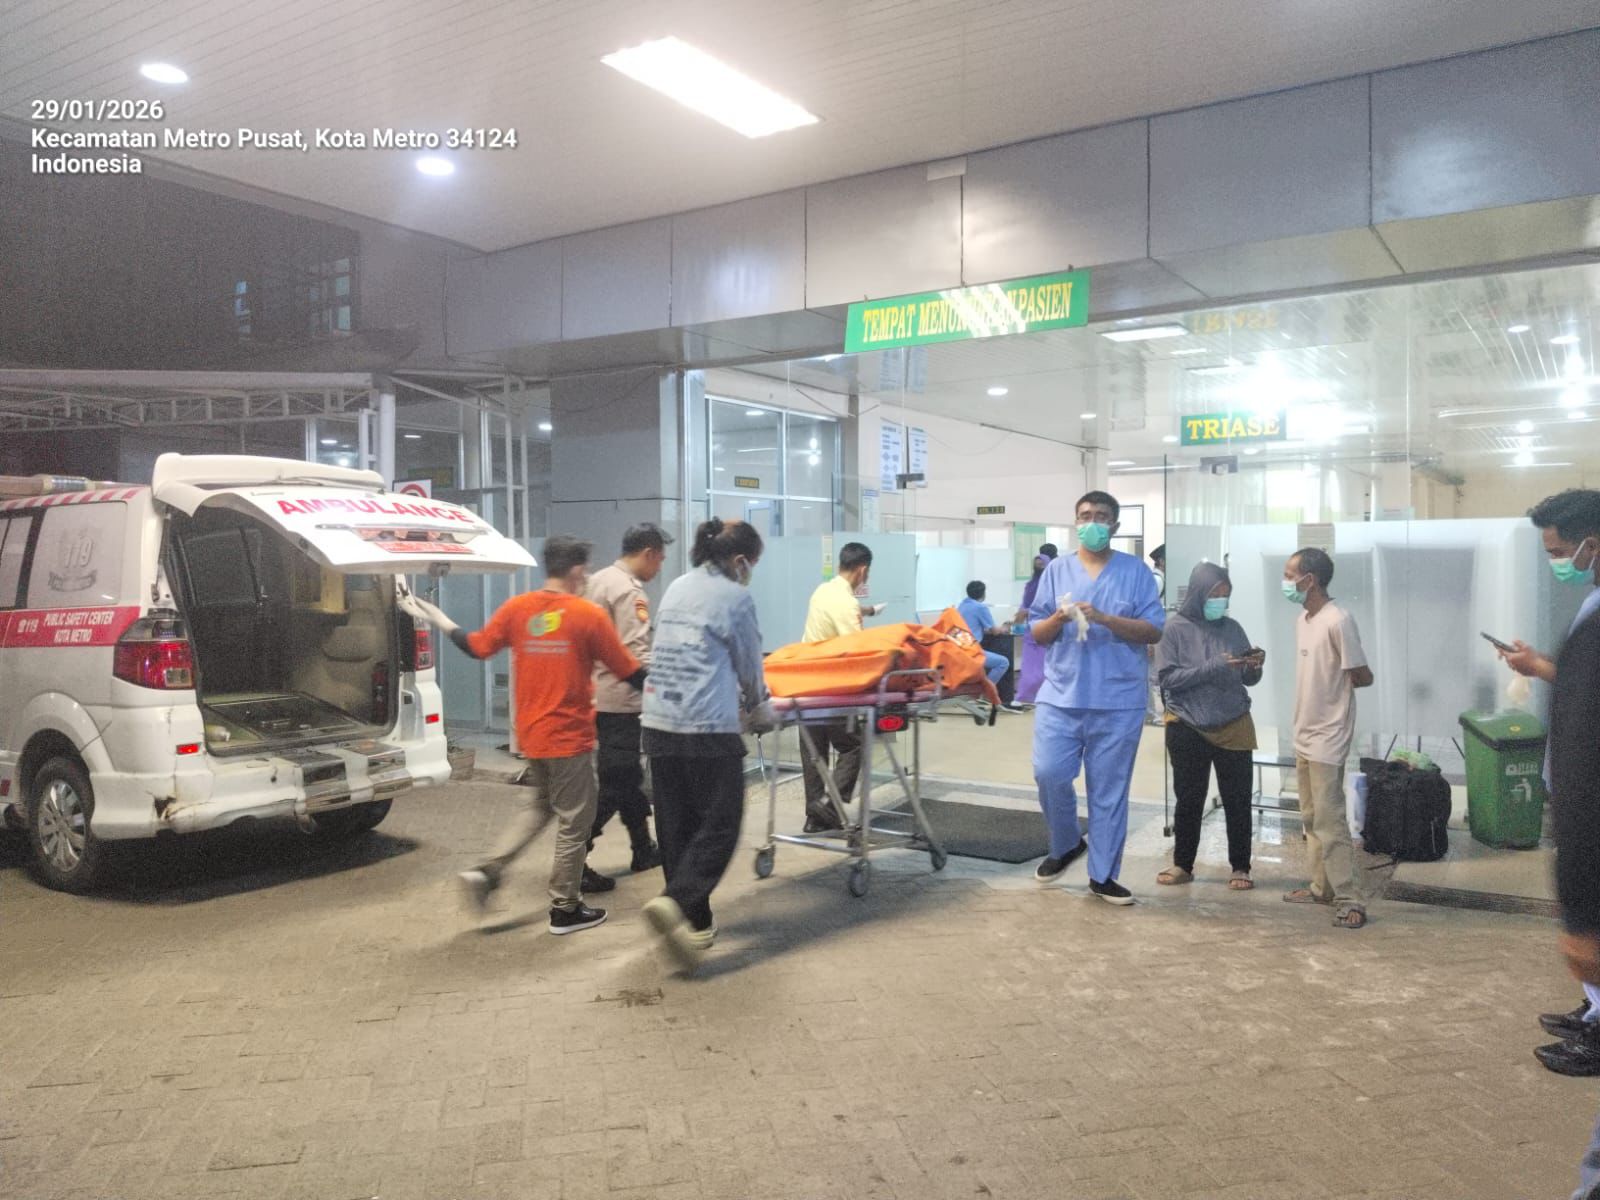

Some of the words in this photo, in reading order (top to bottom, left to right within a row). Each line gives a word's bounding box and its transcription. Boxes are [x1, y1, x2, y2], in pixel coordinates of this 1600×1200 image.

[863, 304, 916, 343] TEMPAT
[1018, 282, 1073, 323] PASIEN
[1187, 416, 1280, 440] TRIASE
[277, 499, 474, 523] AMBULANCE
[65, 610, 89, 625] SAFETY
[88, 610, 115, 624] CENTER
[54, 629, 70, 643] KOTA
[70, 628, 92, 642] METRO
